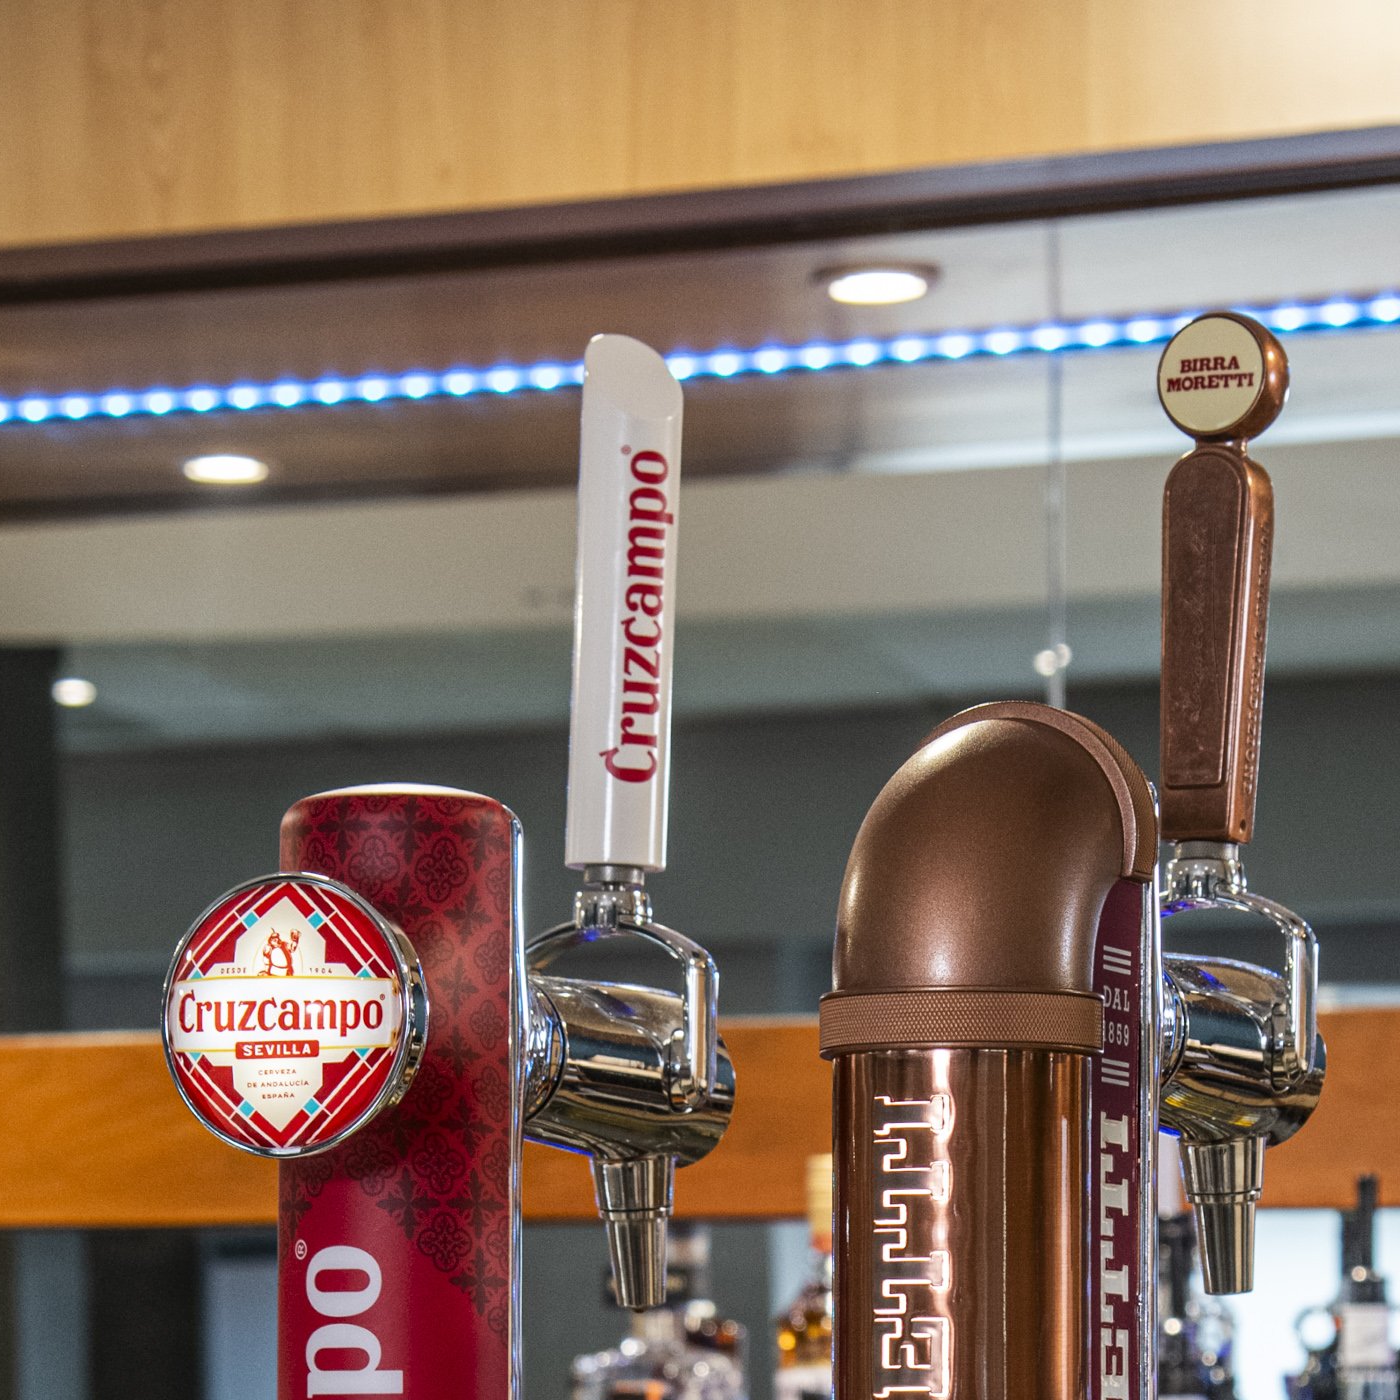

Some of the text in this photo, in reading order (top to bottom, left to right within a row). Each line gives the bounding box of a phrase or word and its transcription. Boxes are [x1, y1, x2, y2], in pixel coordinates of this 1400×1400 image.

[1180, 355, 1240, 374] BIRRA
[1166, 372, 1255, 393] MORETTI
[220, 967, 333, 975] DESDE 1904
[1103, 985, 1130, 1012] DAL
[242, 1044, 312, 1058] SEVILLA
[261, 1092, 295, 1100] ESPAÑA
